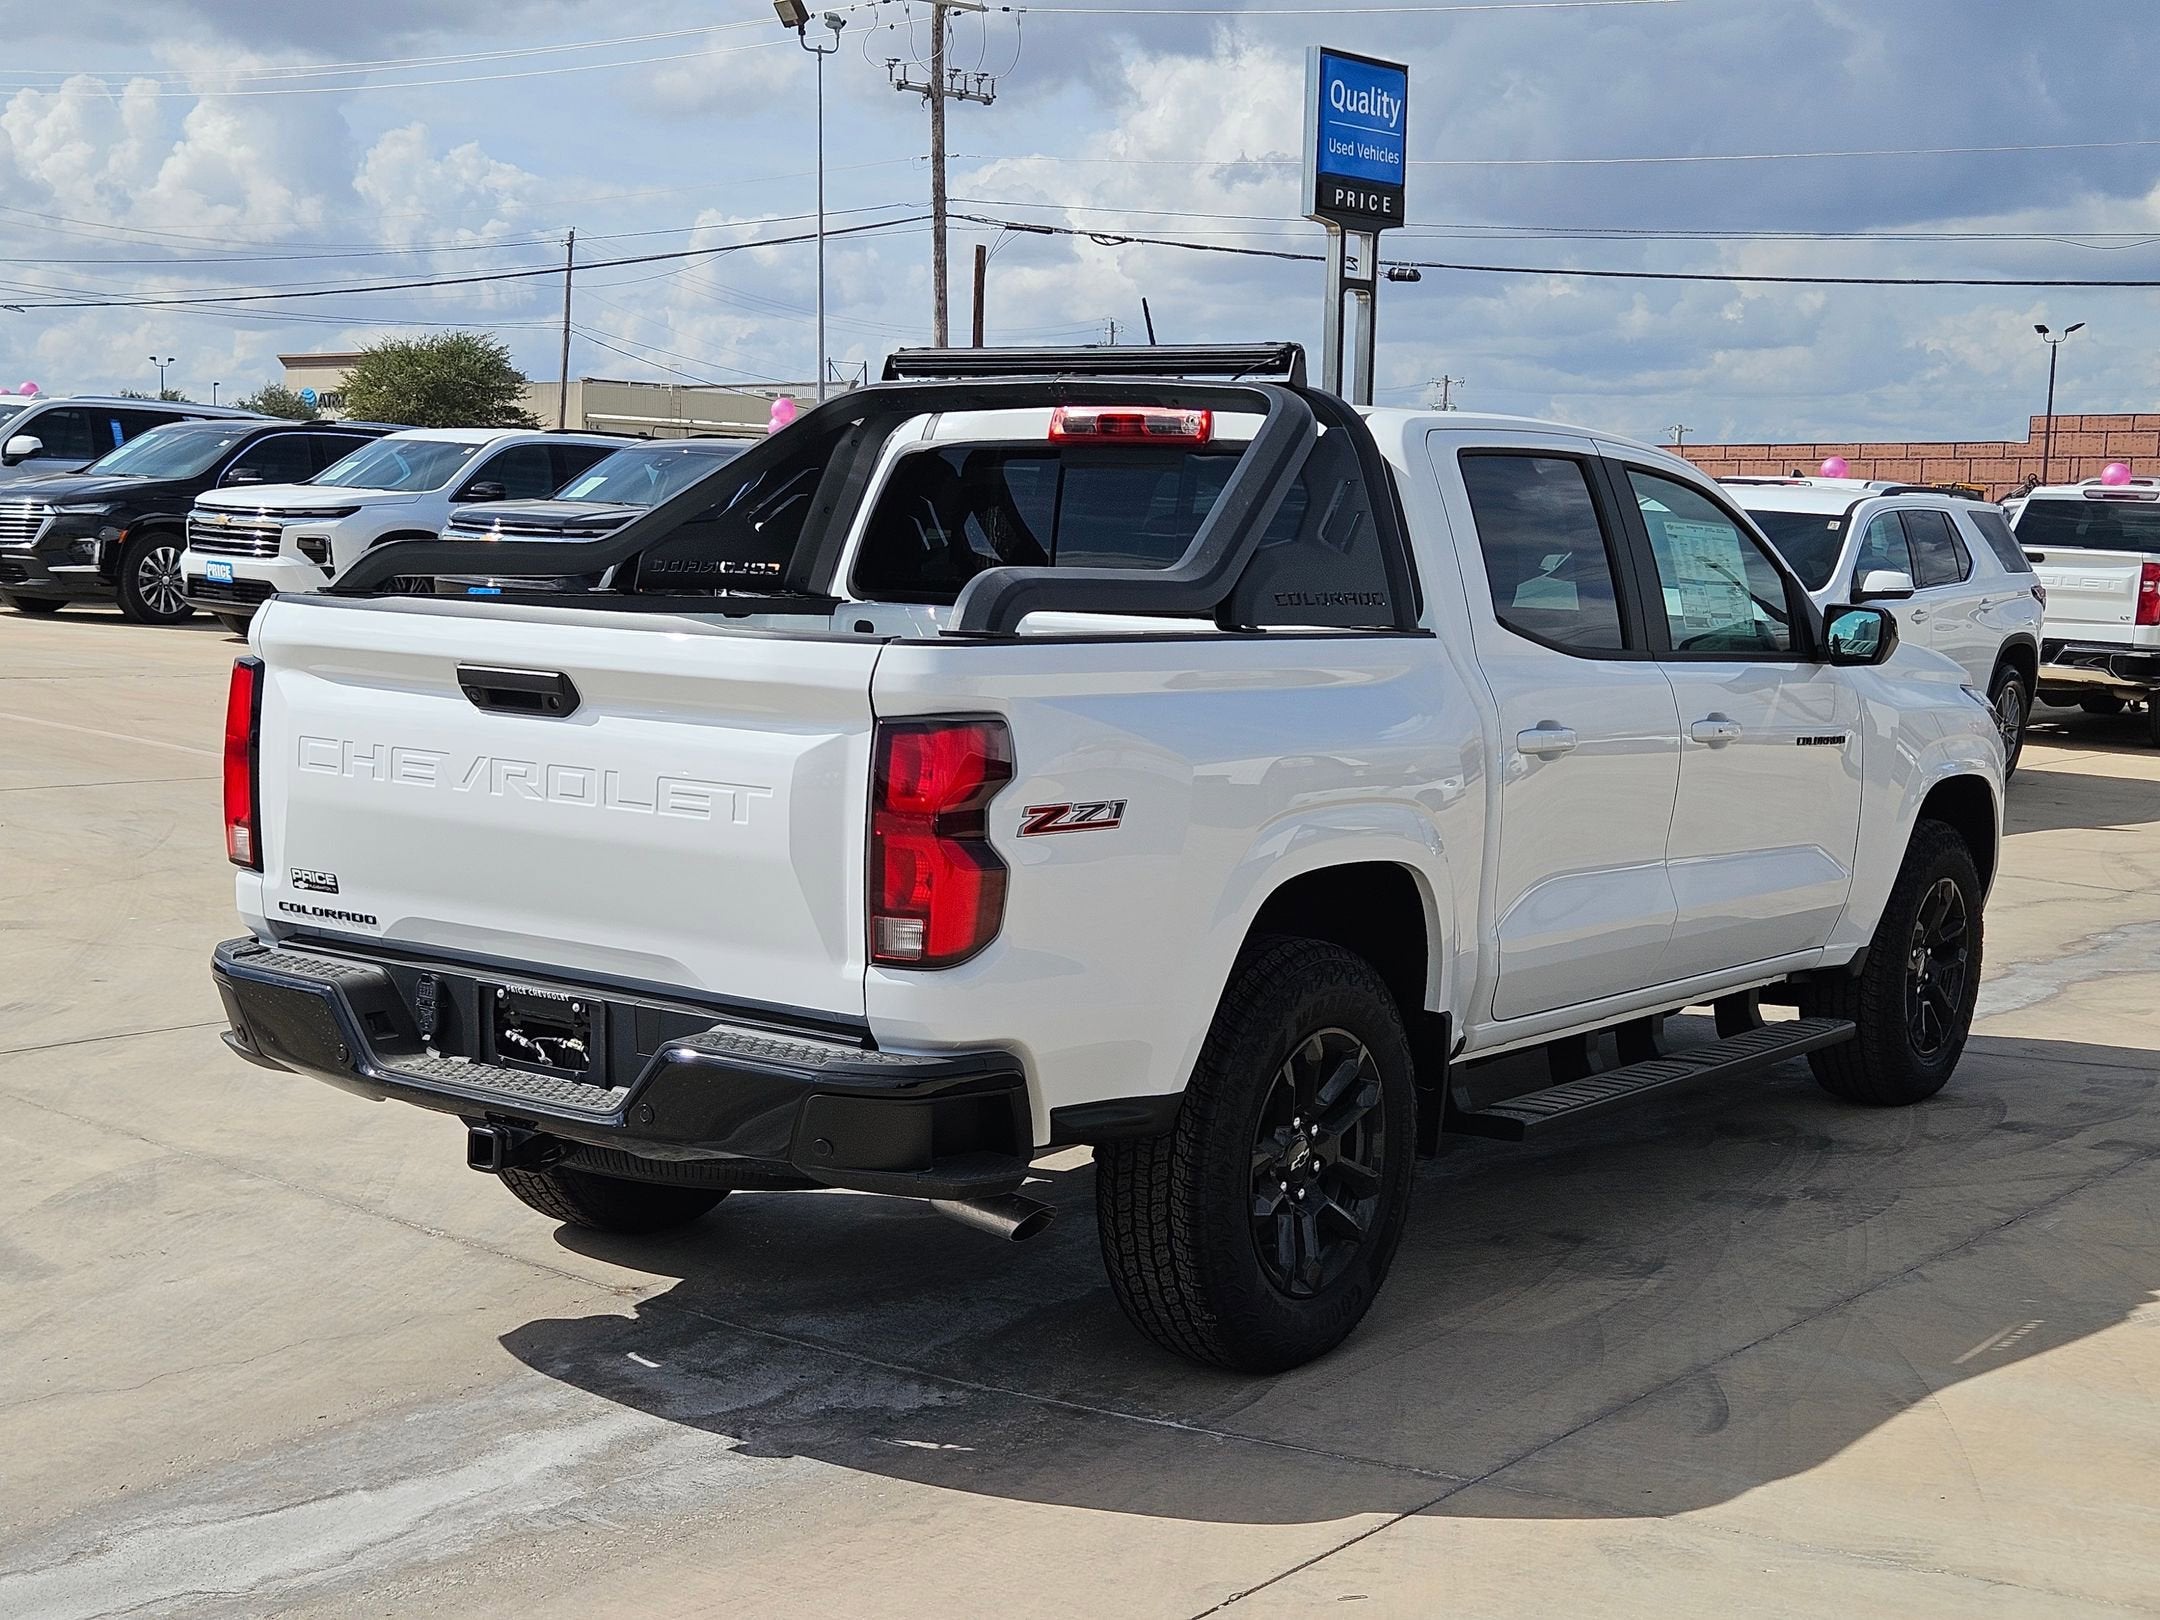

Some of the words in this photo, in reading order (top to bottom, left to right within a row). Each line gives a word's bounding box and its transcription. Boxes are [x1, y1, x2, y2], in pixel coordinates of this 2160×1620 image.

[1330, 79, 1402, 128] Quality
[1329, 137, 1354, 156] Used
[1357, 143, 1400, 165] Vehicles
[1335, 188, 1392, 213] PRICE
[207, 563, 231, 578] PRICE
[1274, 591, 1386, 607] COLORADO
[298, 735, 773, 825] CHEVROLET
[1016, 799, 1128, 838] Z71
[292, 869, 336, 885] PRICE
[278, 901, 377, 925] COLORADO
[506, 985, 527, 995] PRICE
[529, 989, 570, 1001] CHEVROLET
